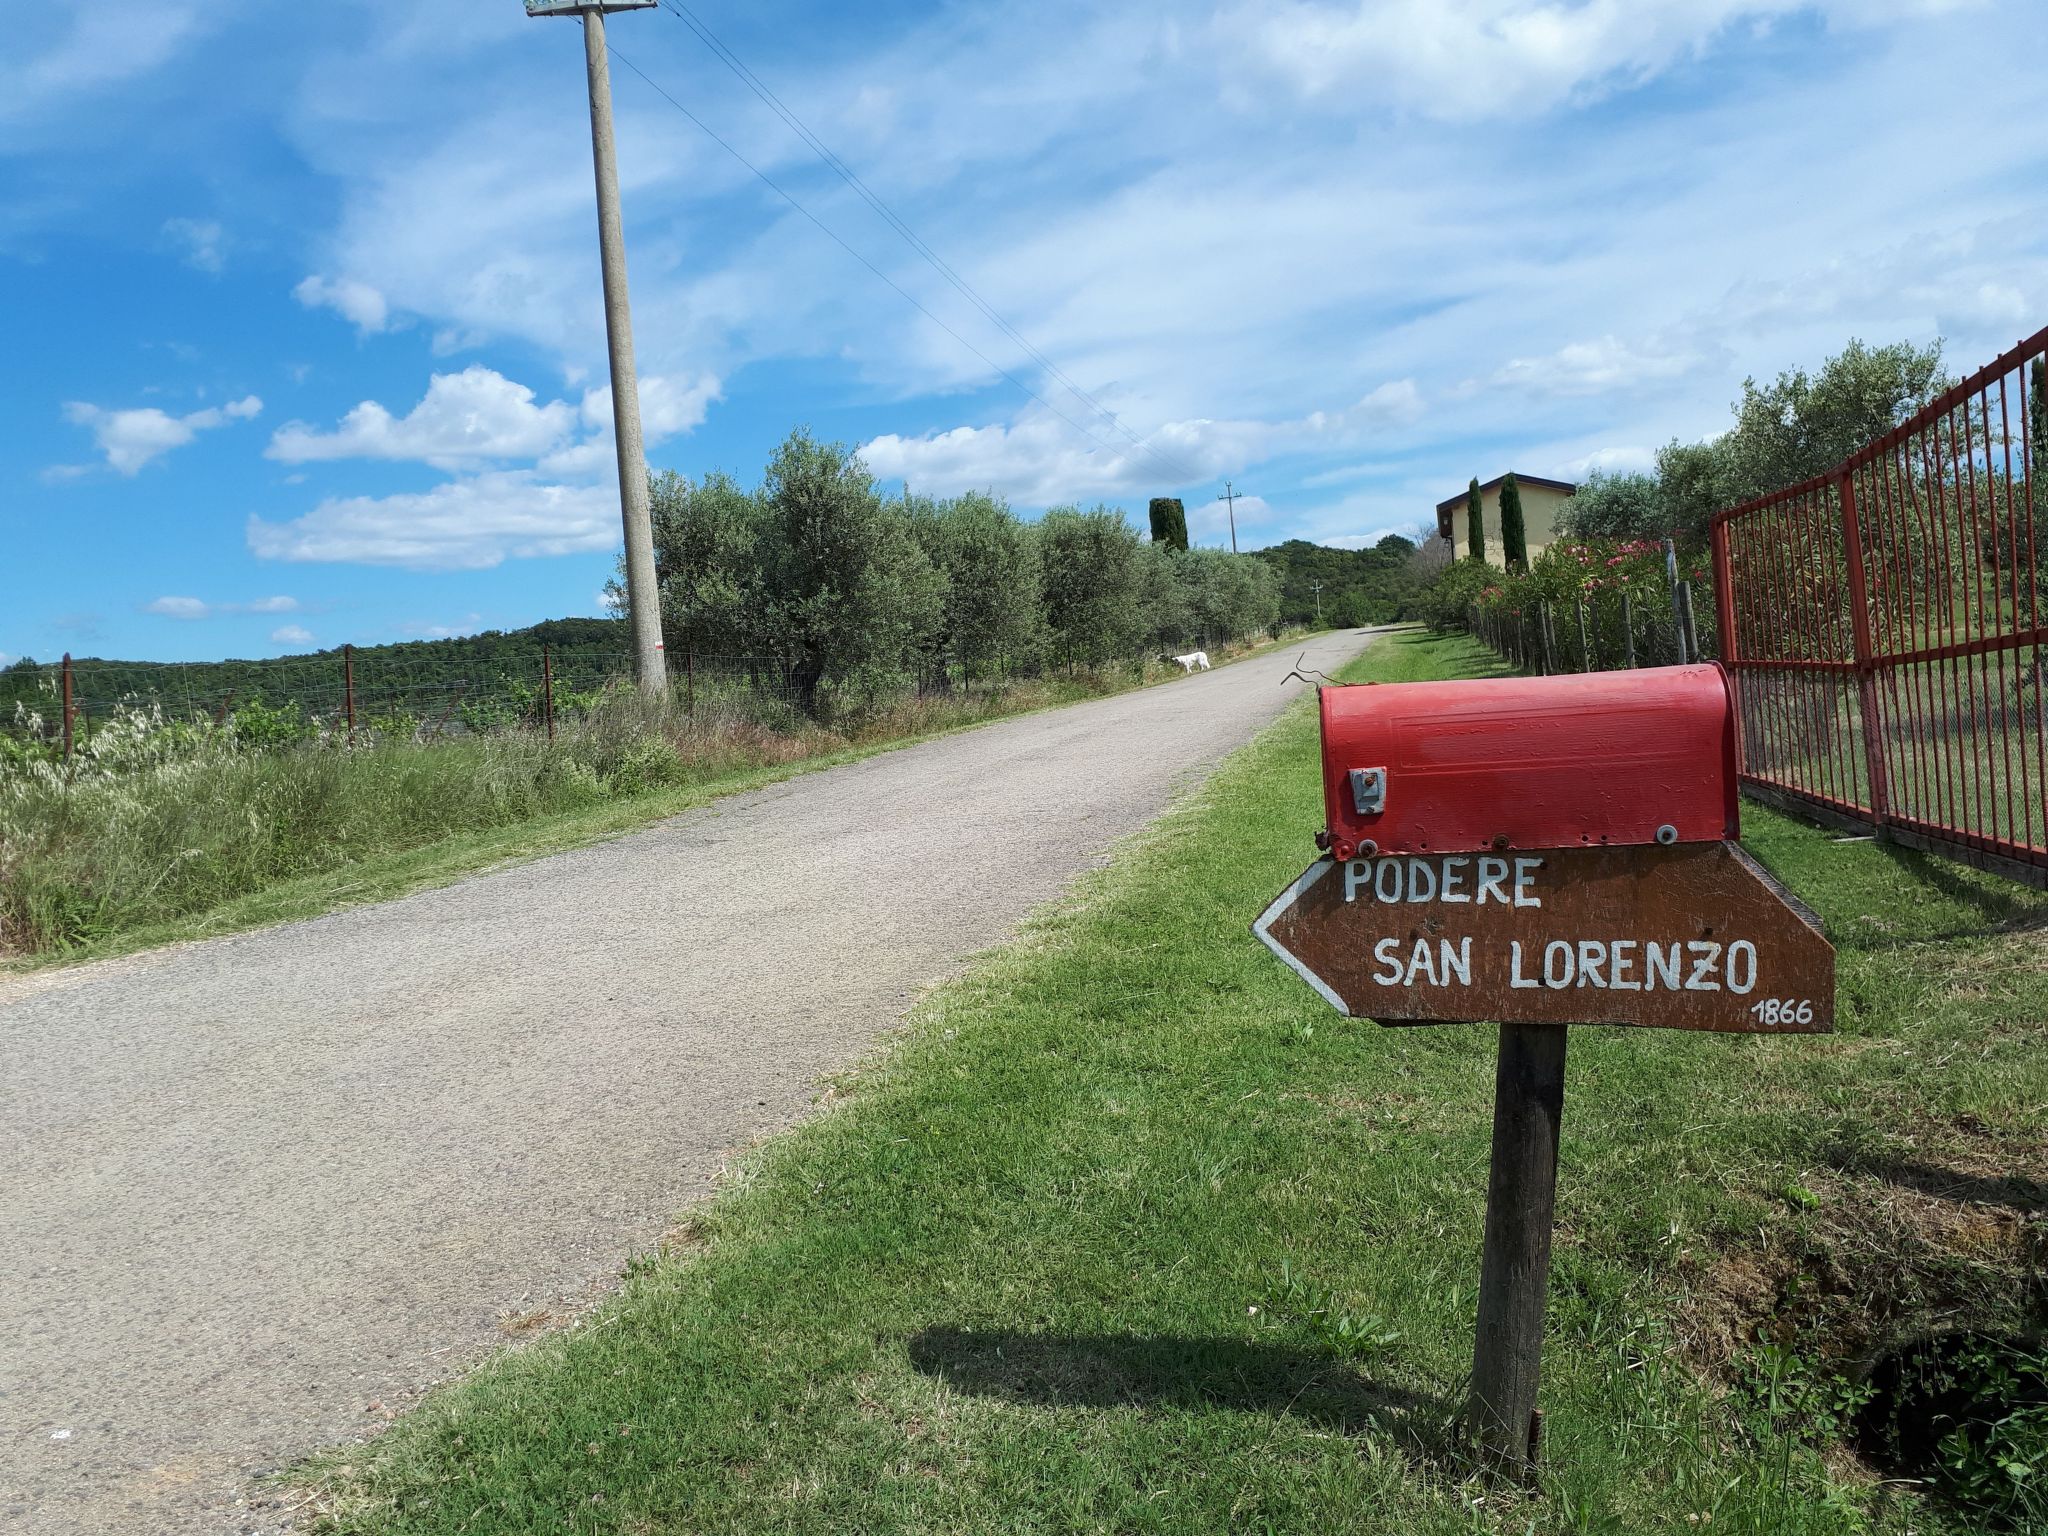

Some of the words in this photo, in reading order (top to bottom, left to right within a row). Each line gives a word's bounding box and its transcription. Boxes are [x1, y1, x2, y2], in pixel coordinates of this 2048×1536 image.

[1344, 857, 1544, 908] PODERE
[1372, 937, 1473, 987] SAN
[1509, 939, 1759, 995] LORENZO
[1750, 998, 1814, 1024] 1866
